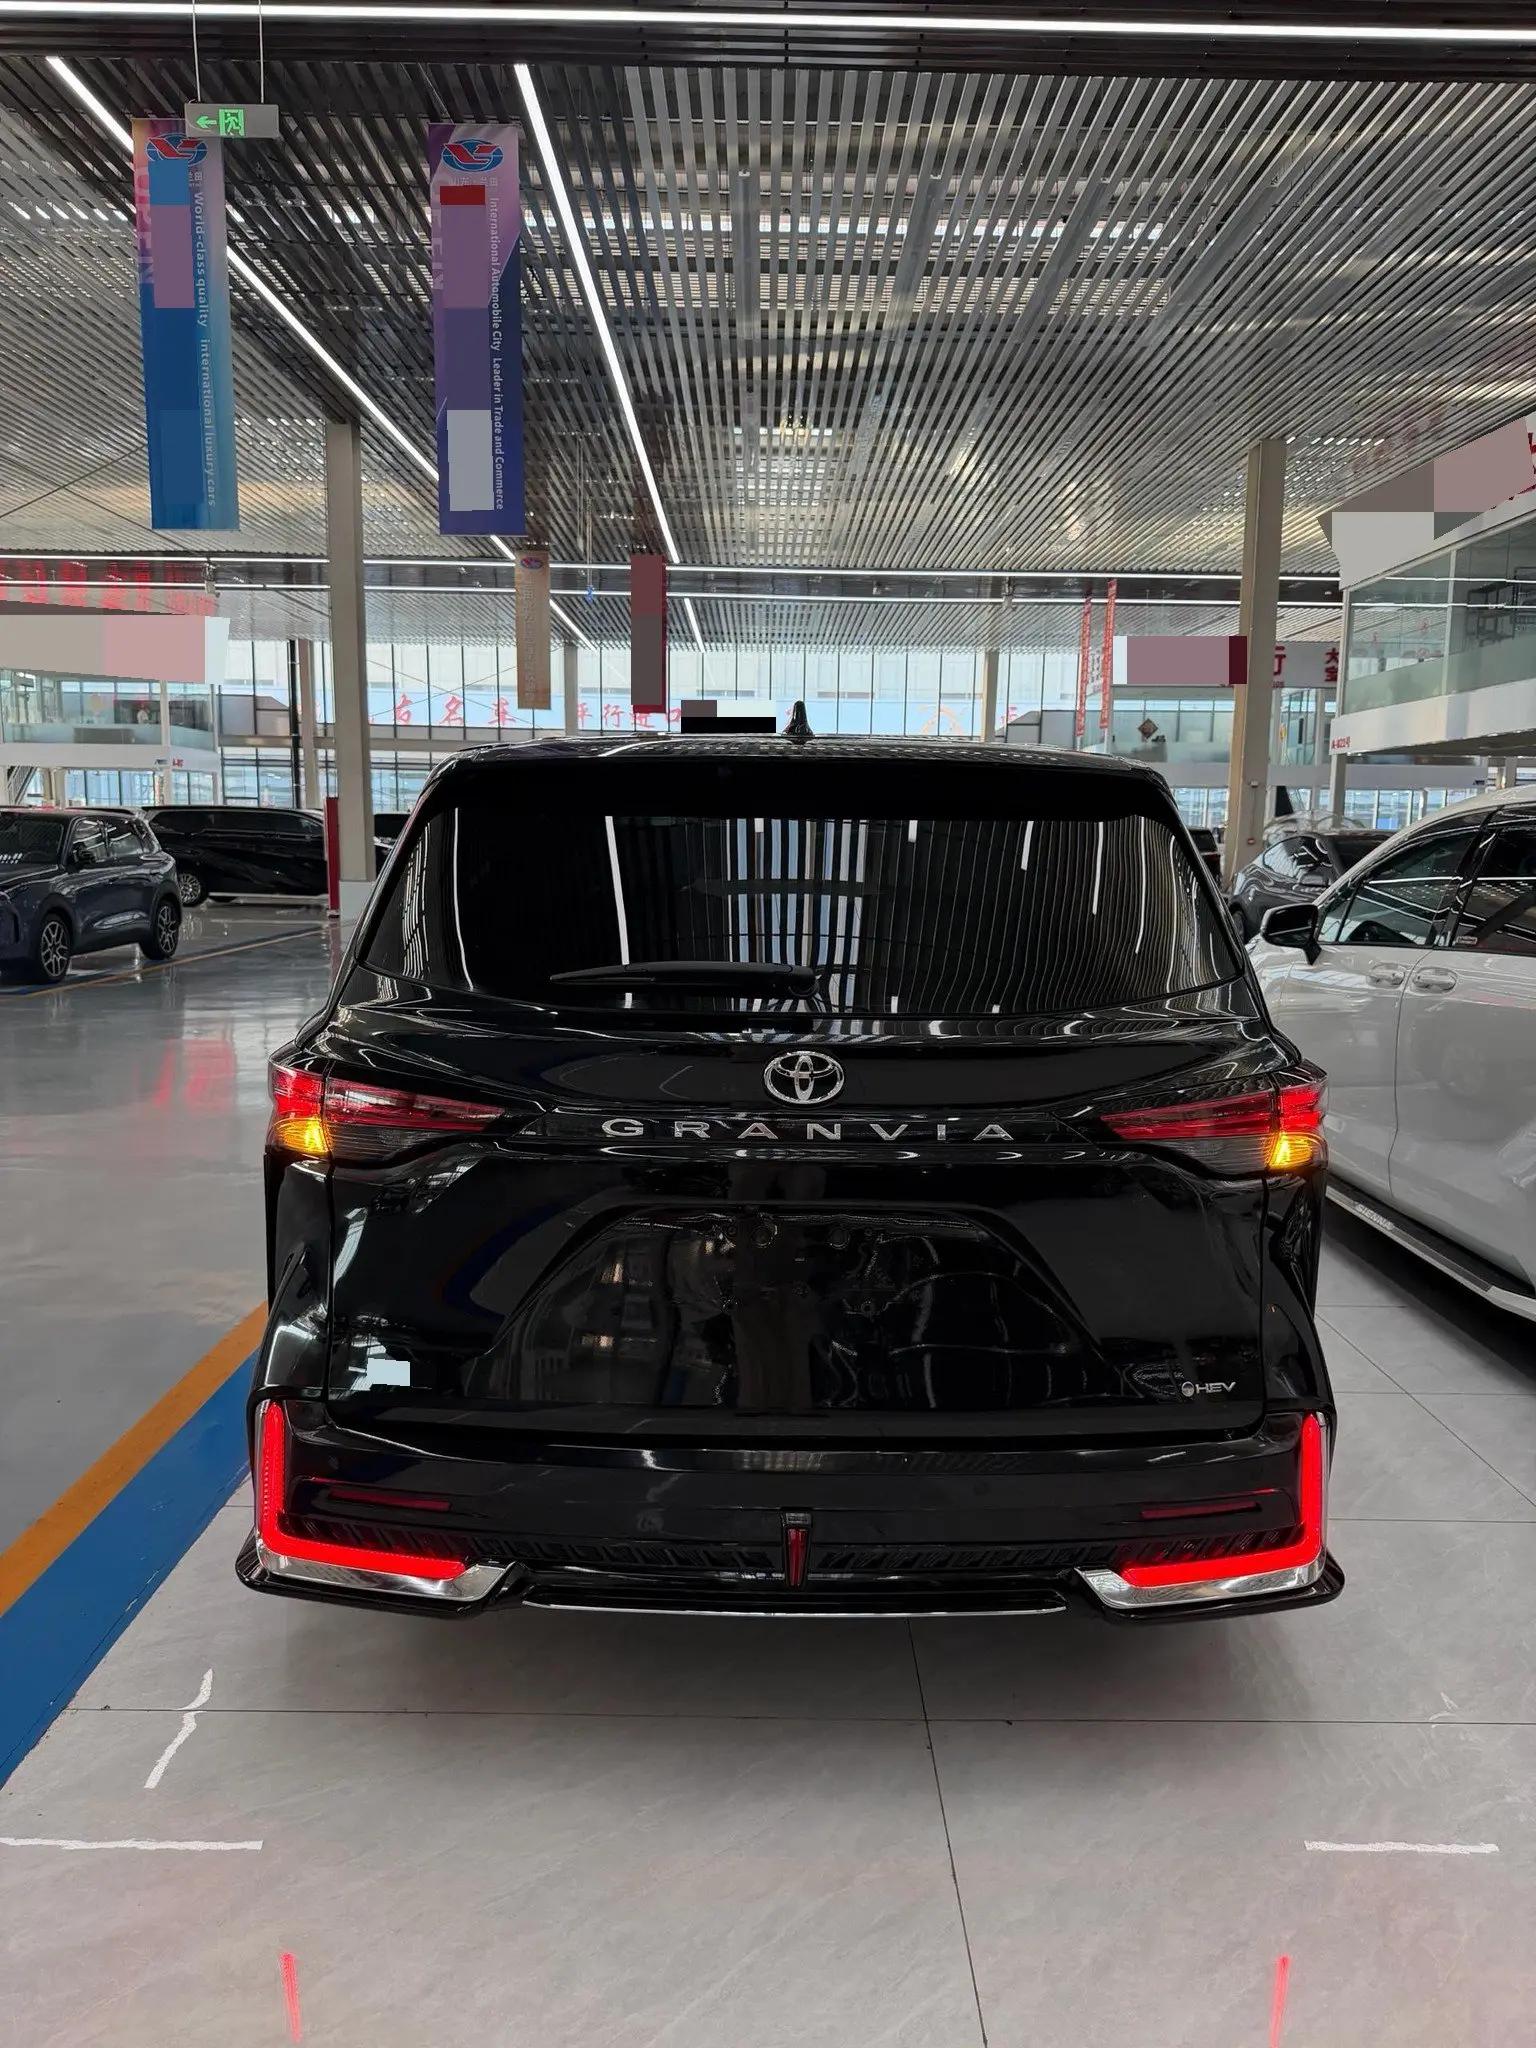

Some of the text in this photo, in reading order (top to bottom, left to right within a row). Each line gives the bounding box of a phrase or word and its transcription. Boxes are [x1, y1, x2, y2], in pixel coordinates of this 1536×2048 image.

[193, 191, 205, 275] World-class
[195, 277, 209, 327] quality
[489, 197, 505, 511] International Automobile City Leader in Trade and Commerce
[200, 338, 214, 429] international
[203, 432, 217, 476] luxury
[601, 1117, 1015, 1142] GRANVIA
[1355, 1203, 1396, 1231] SIENNA
[1195, 1381, 1237, 1394] HEV
